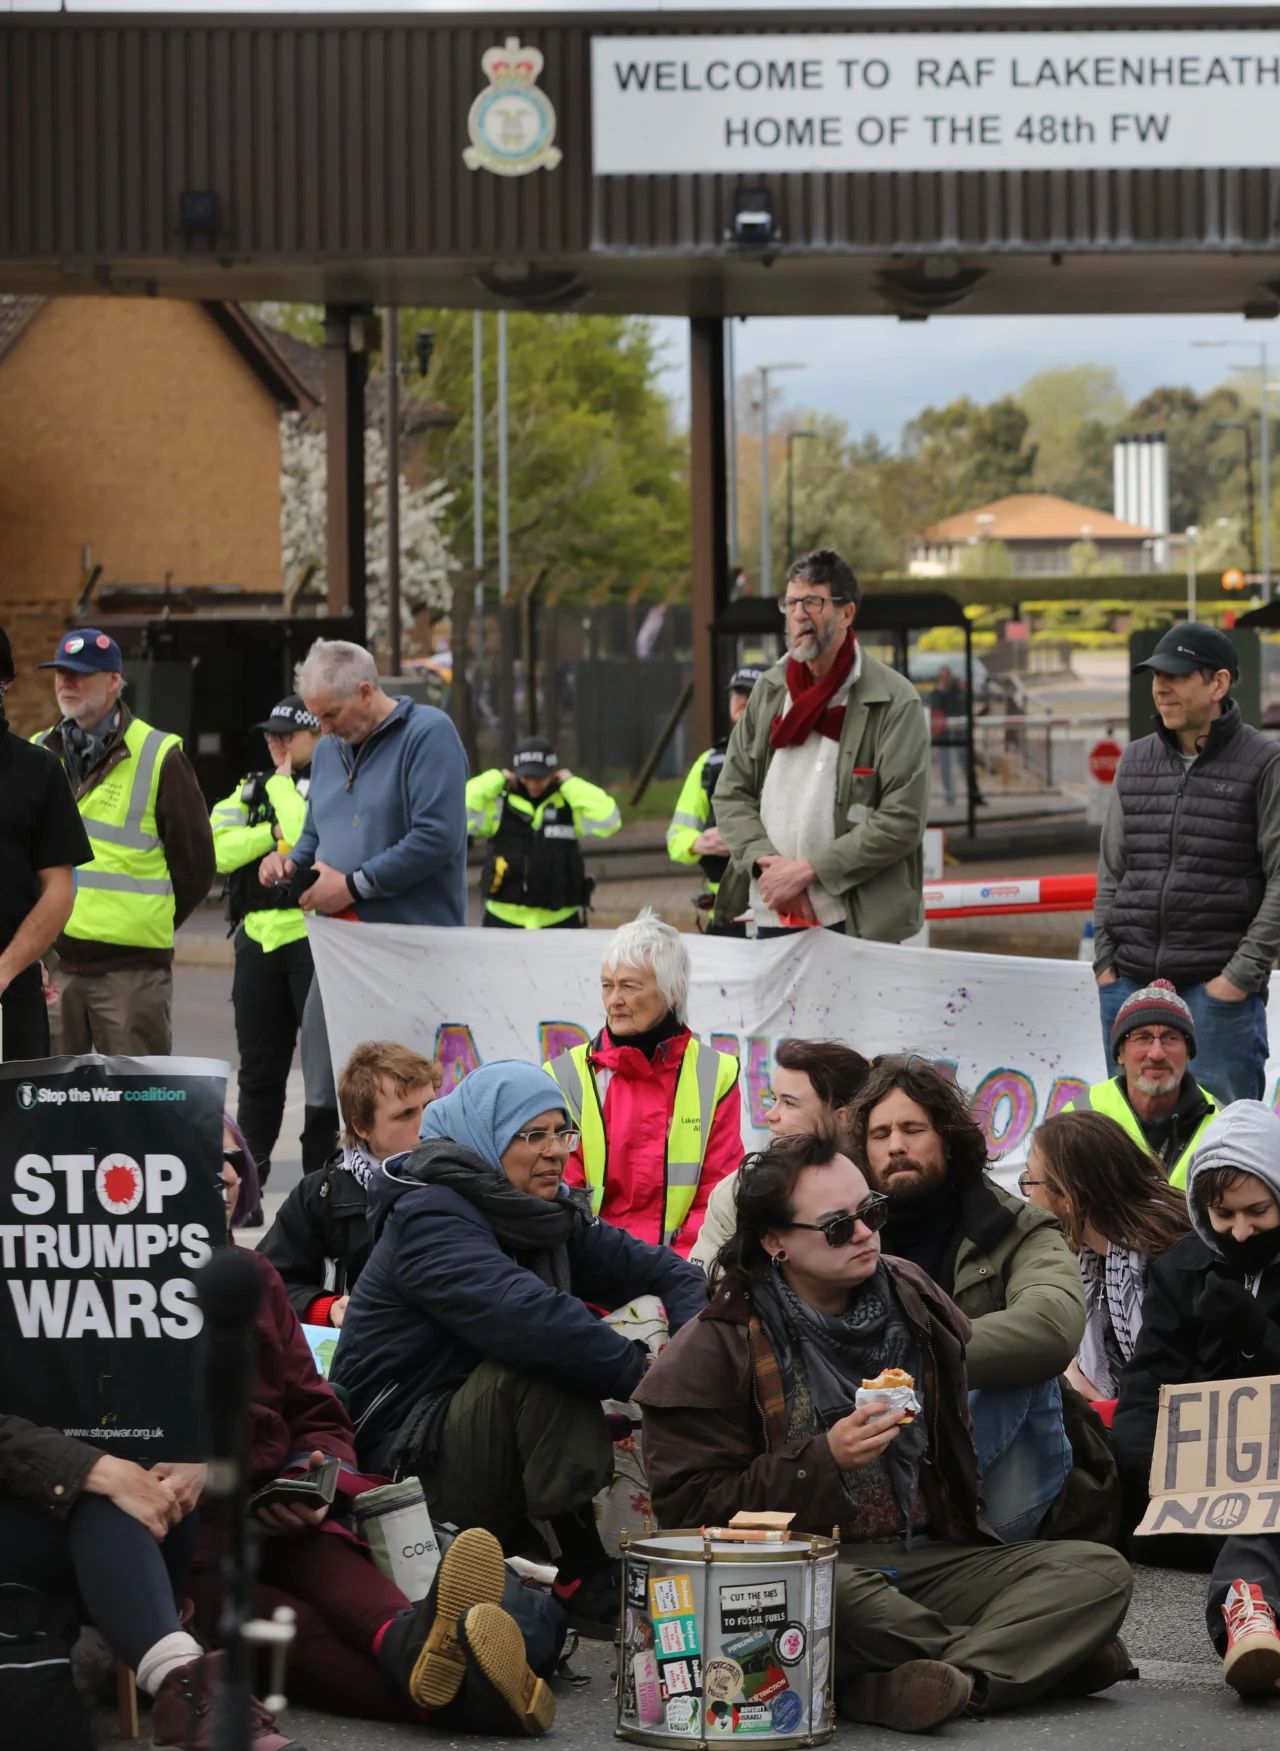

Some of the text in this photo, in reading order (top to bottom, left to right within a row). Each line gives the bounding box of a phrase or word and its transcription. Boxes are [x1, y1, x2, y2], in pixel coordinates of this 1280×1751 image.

[614, 56, 1280, 92] WELCOME TO RAF LAKENHEATH
[724, 113, 1171, 147] HOME OF THE 48th FW
[433, 1022, 486, 1098] A
[37, 1087, 187, 1105] Stop the War coalition
[11, 1153, 187, 1215] STOP
[0, 1223, 213, 1269] TRUMP'S
[7, 1278, 204, 1340] WARS
[63, 1427, 165, 1440] www.stopwar.org.uk
[681, 1580, 690, 1608] Defend
[730, 1588, 778, 1602] CUT THE TIES
[724, 1612, 785, 1626] TO FOSSIL FUELS
[675, 1634, 683, 1650] right
[686, 1621, 696, 1649] Defend
[727, 1632, 763, 1653] PIPELINE TO
[681, 1673, 689, 1690] right
[692, 1660, 702, 1688] Defend
